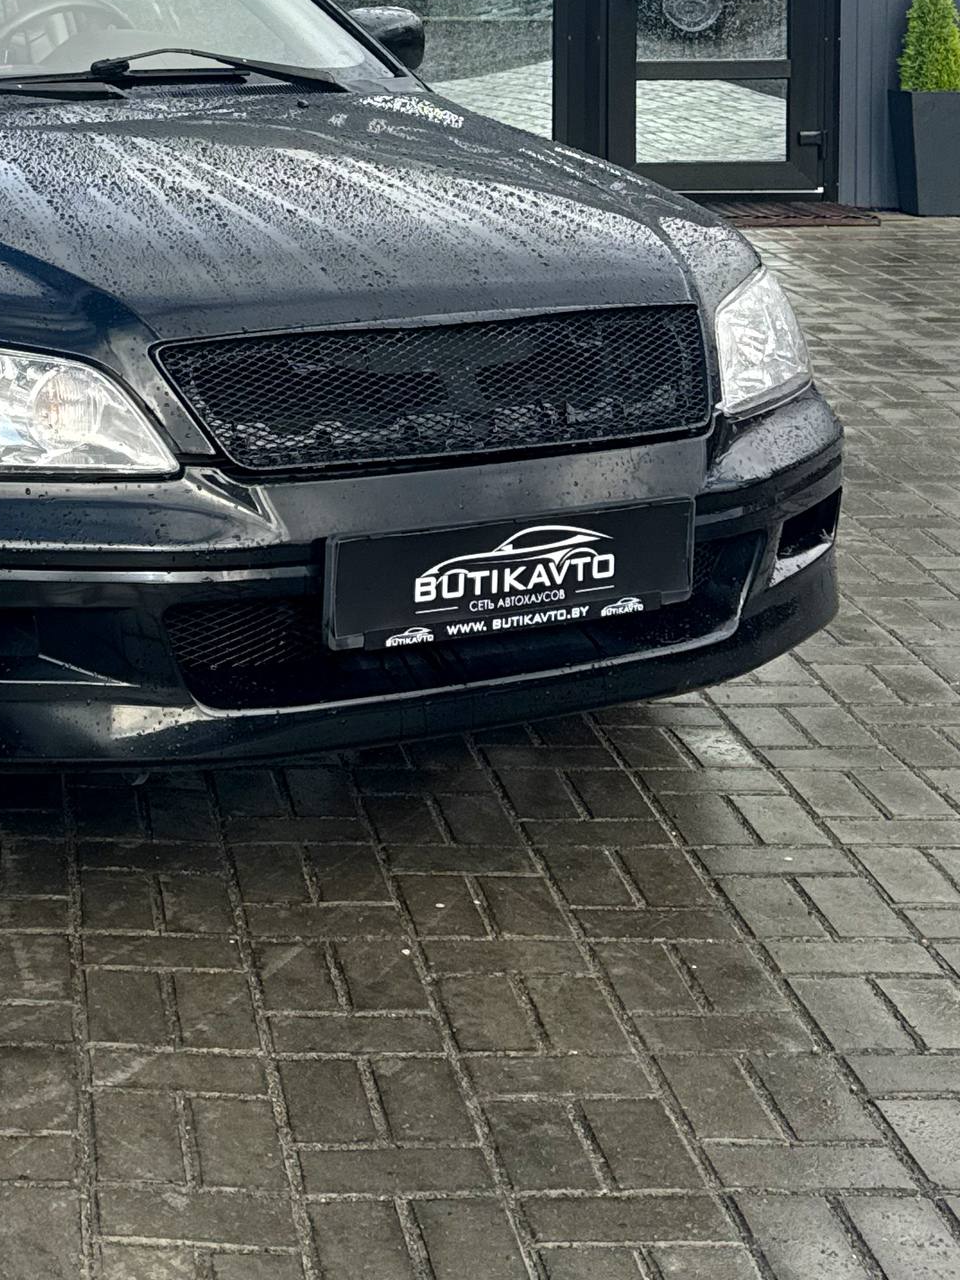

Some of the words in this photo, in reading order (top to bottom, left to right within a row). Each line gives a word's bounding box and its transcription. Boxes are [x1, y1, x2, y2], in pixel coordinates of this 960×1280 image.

[414, 553, 615, 603] BUTIKAVTO
[469, 600, 495, 612] СЕТЬ
[497, 589, 566, 609] АВТОХАУСОВ
[600, 603, 644, 617] BUTIKAVTO
[446, 620, 488, 636] WWW.
[492, 606, 590, 631] BUTIKAVTO.BY
[385, 633, 434, 648] BUTIKAVTO
